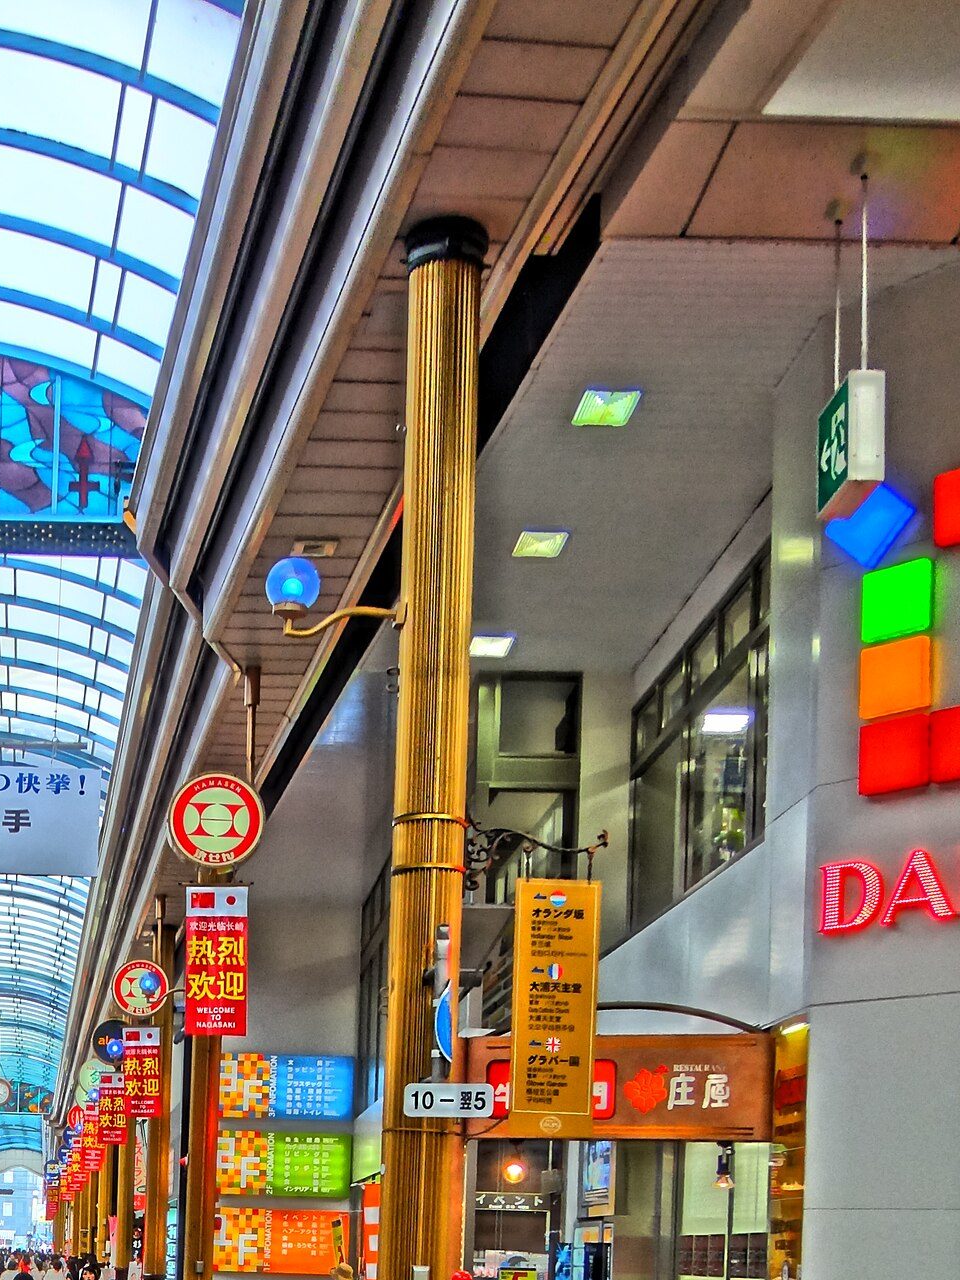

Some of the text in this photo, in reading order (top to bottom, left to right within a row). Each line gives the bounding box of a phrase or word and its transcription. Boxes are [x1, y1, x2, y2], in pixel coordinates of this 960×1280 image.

[193, 780, 242, 793] HAMASEN
[190, 921, 244, 933] 欢迎光临长崎
[187, 936, 245, 966] 热烈
[187, 971, 246, 1001] 欢迎
[529, 981, 583, 994] 大浦天主堂
[196, 1021, 236, 1029] NAGASAKI
[124, 1057, 160, 1076] 热烈
[124, 1078, 160, 1097] 欢迎
[667, 1073, 730, 1110] 庄屋
[475, 1194, 543, 1206] イベント
